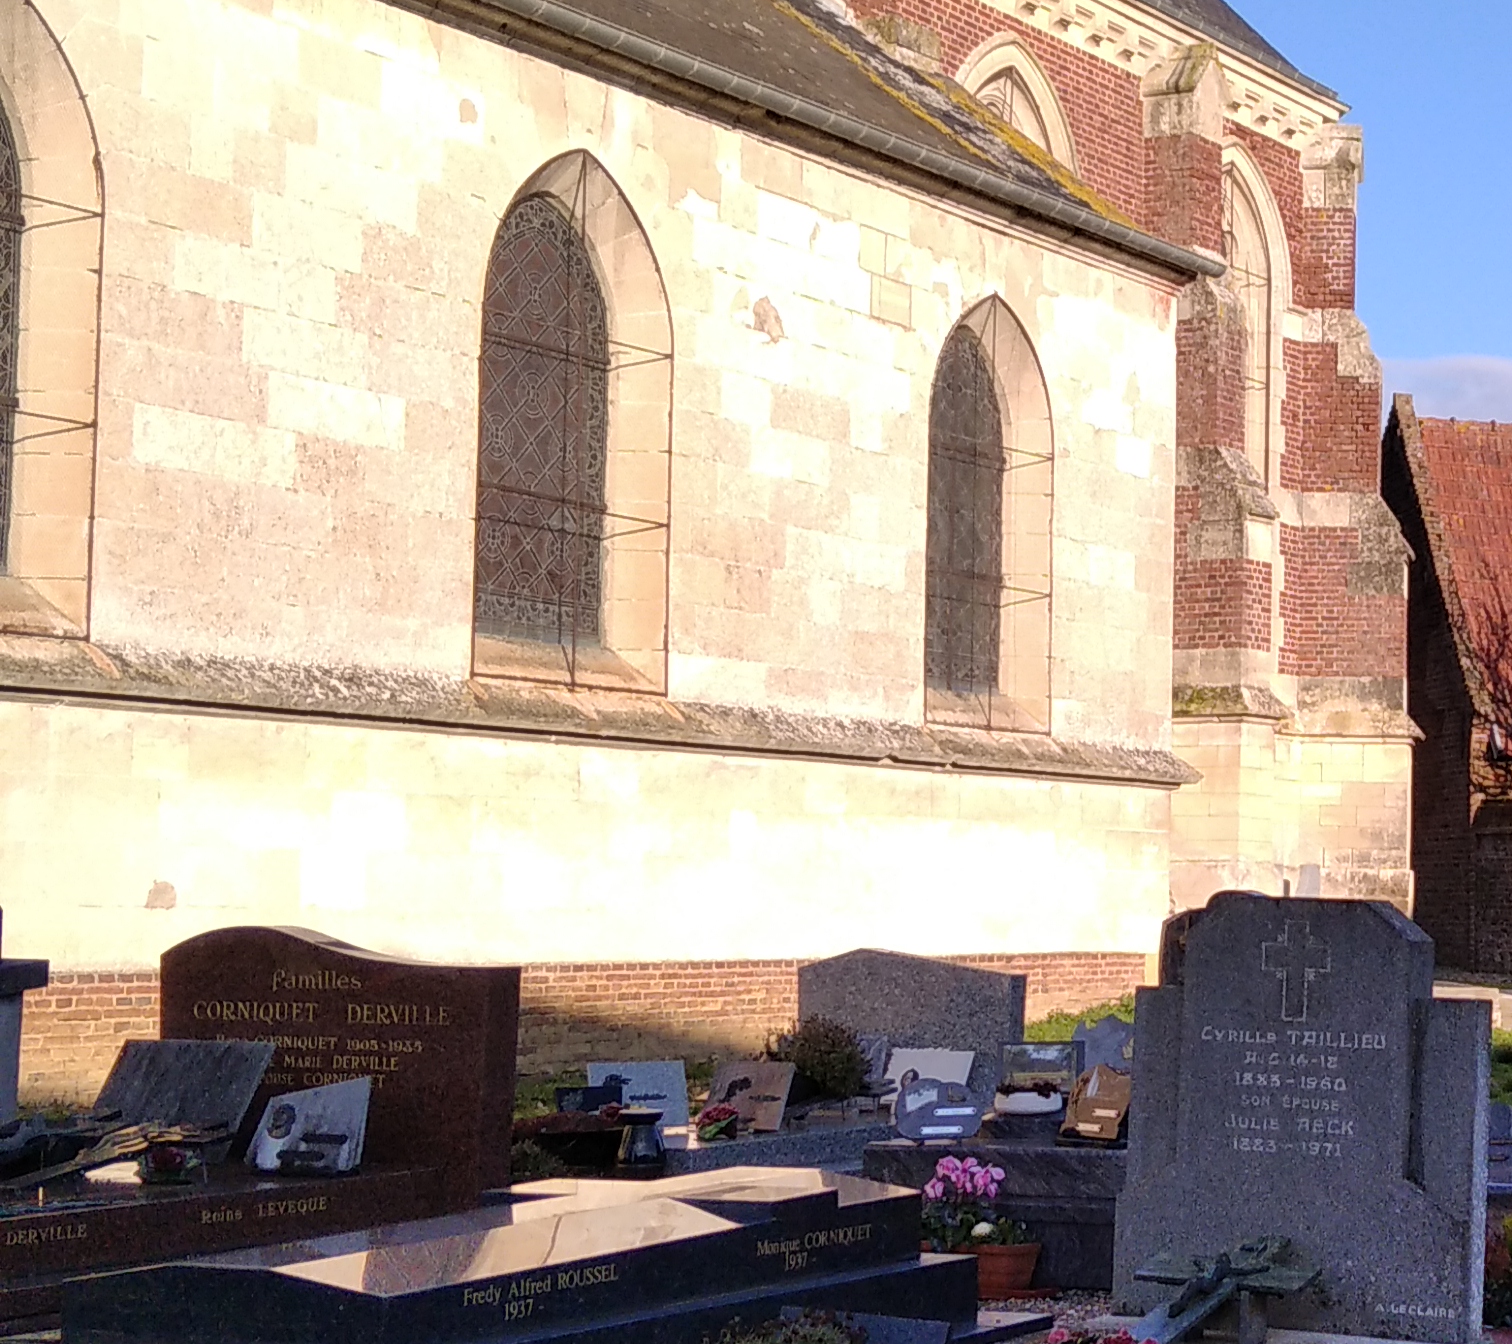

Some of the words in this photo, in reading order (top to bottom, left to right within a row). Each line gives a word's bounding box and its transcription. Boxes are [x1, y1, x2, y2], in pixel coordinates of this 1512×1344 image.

[272, 969, 362, 992] Familles
[193, 1000, 319, 1025] CORNIQUET
[347, 1003, 450, 1025] DERVILLE
[1287, 1030, 1387, 1050] TAILLIEU
[283, 1055, 323, 1069] MARIE
[332, 1055, 399, 1071] DERVILLE
[1241, 1094, 1271, 1106] SON
[1224, 1113, 1279, 1130] JULIE
[201, 1206, 243, 1224] Reine
[4, 1222, 88, 1246] DERVILLE
[757, 1238, 800, 1258] Monique
[804, 1223, 872, 1250] CORNIQUET
[785, 1251, 808, 1272] 1937
[463, 1284, 502, 1307] Fredy
[508, 1275, 551, 1299] Alfred
[557, 1263, 619, 1290] ROUSSEL
[504, 1298, 534, 1321] 1937
